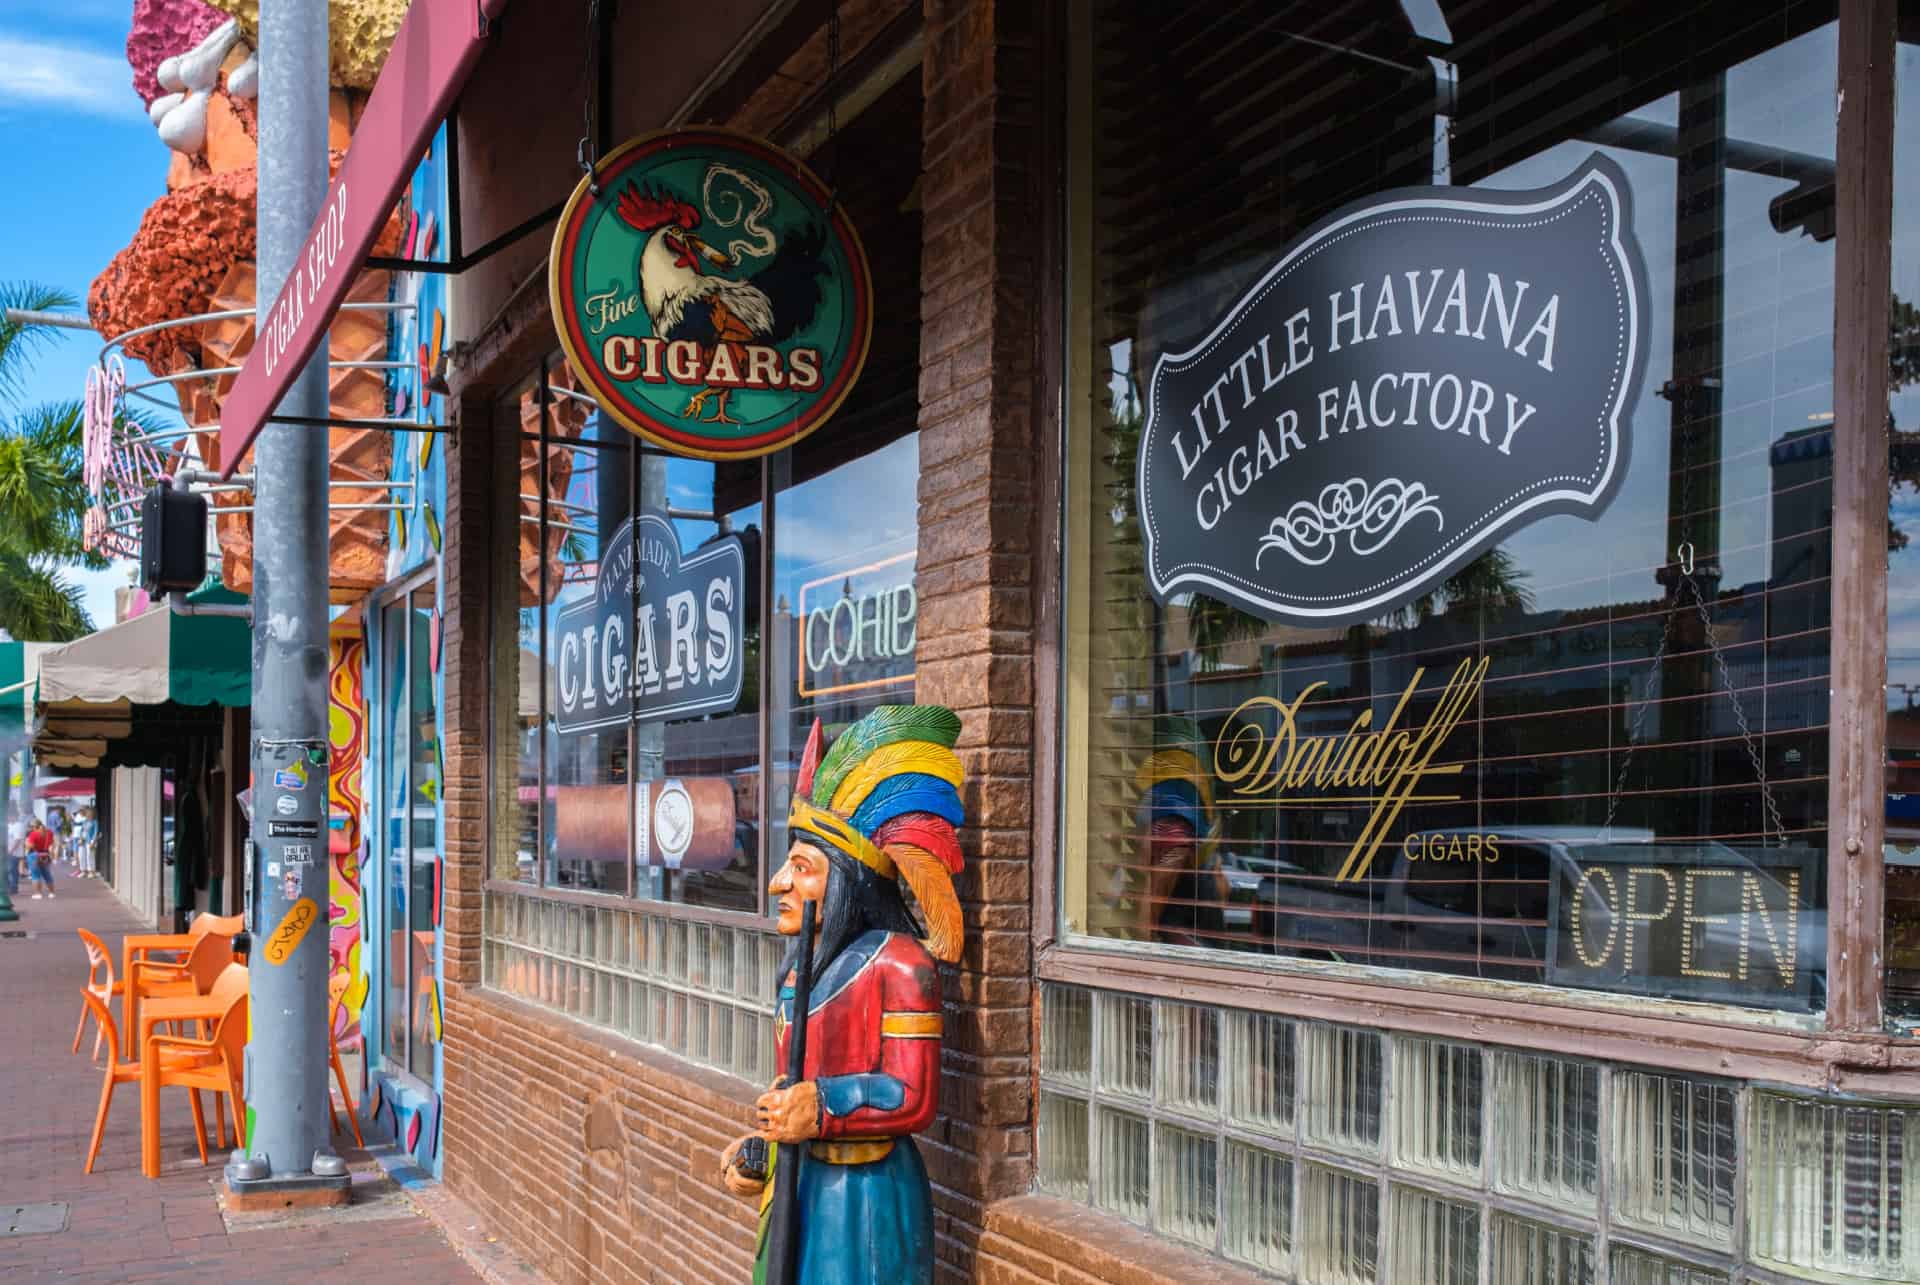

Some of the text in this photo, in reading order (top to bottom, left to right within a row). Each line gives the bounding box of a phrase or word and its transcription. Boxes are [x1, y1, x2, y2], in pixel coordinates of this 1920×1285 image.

[265, 182, 347, 377] CIGAR SHOP
[585, 284, 640, 334] Fine
[603, 336, 822, 391] CIGARS
[1170, 268, 1560, 480] LITTLE HAVANA
[1196, 371, 1536, 531] CIGAR FACTORY
[559, 576, 734, 712] CIGARS
[1214, 655, 1490, 882] Davidoff
[1403, 833, 1499, 863] CIGARS
[1571, 866, 1799, 986] OPEN
